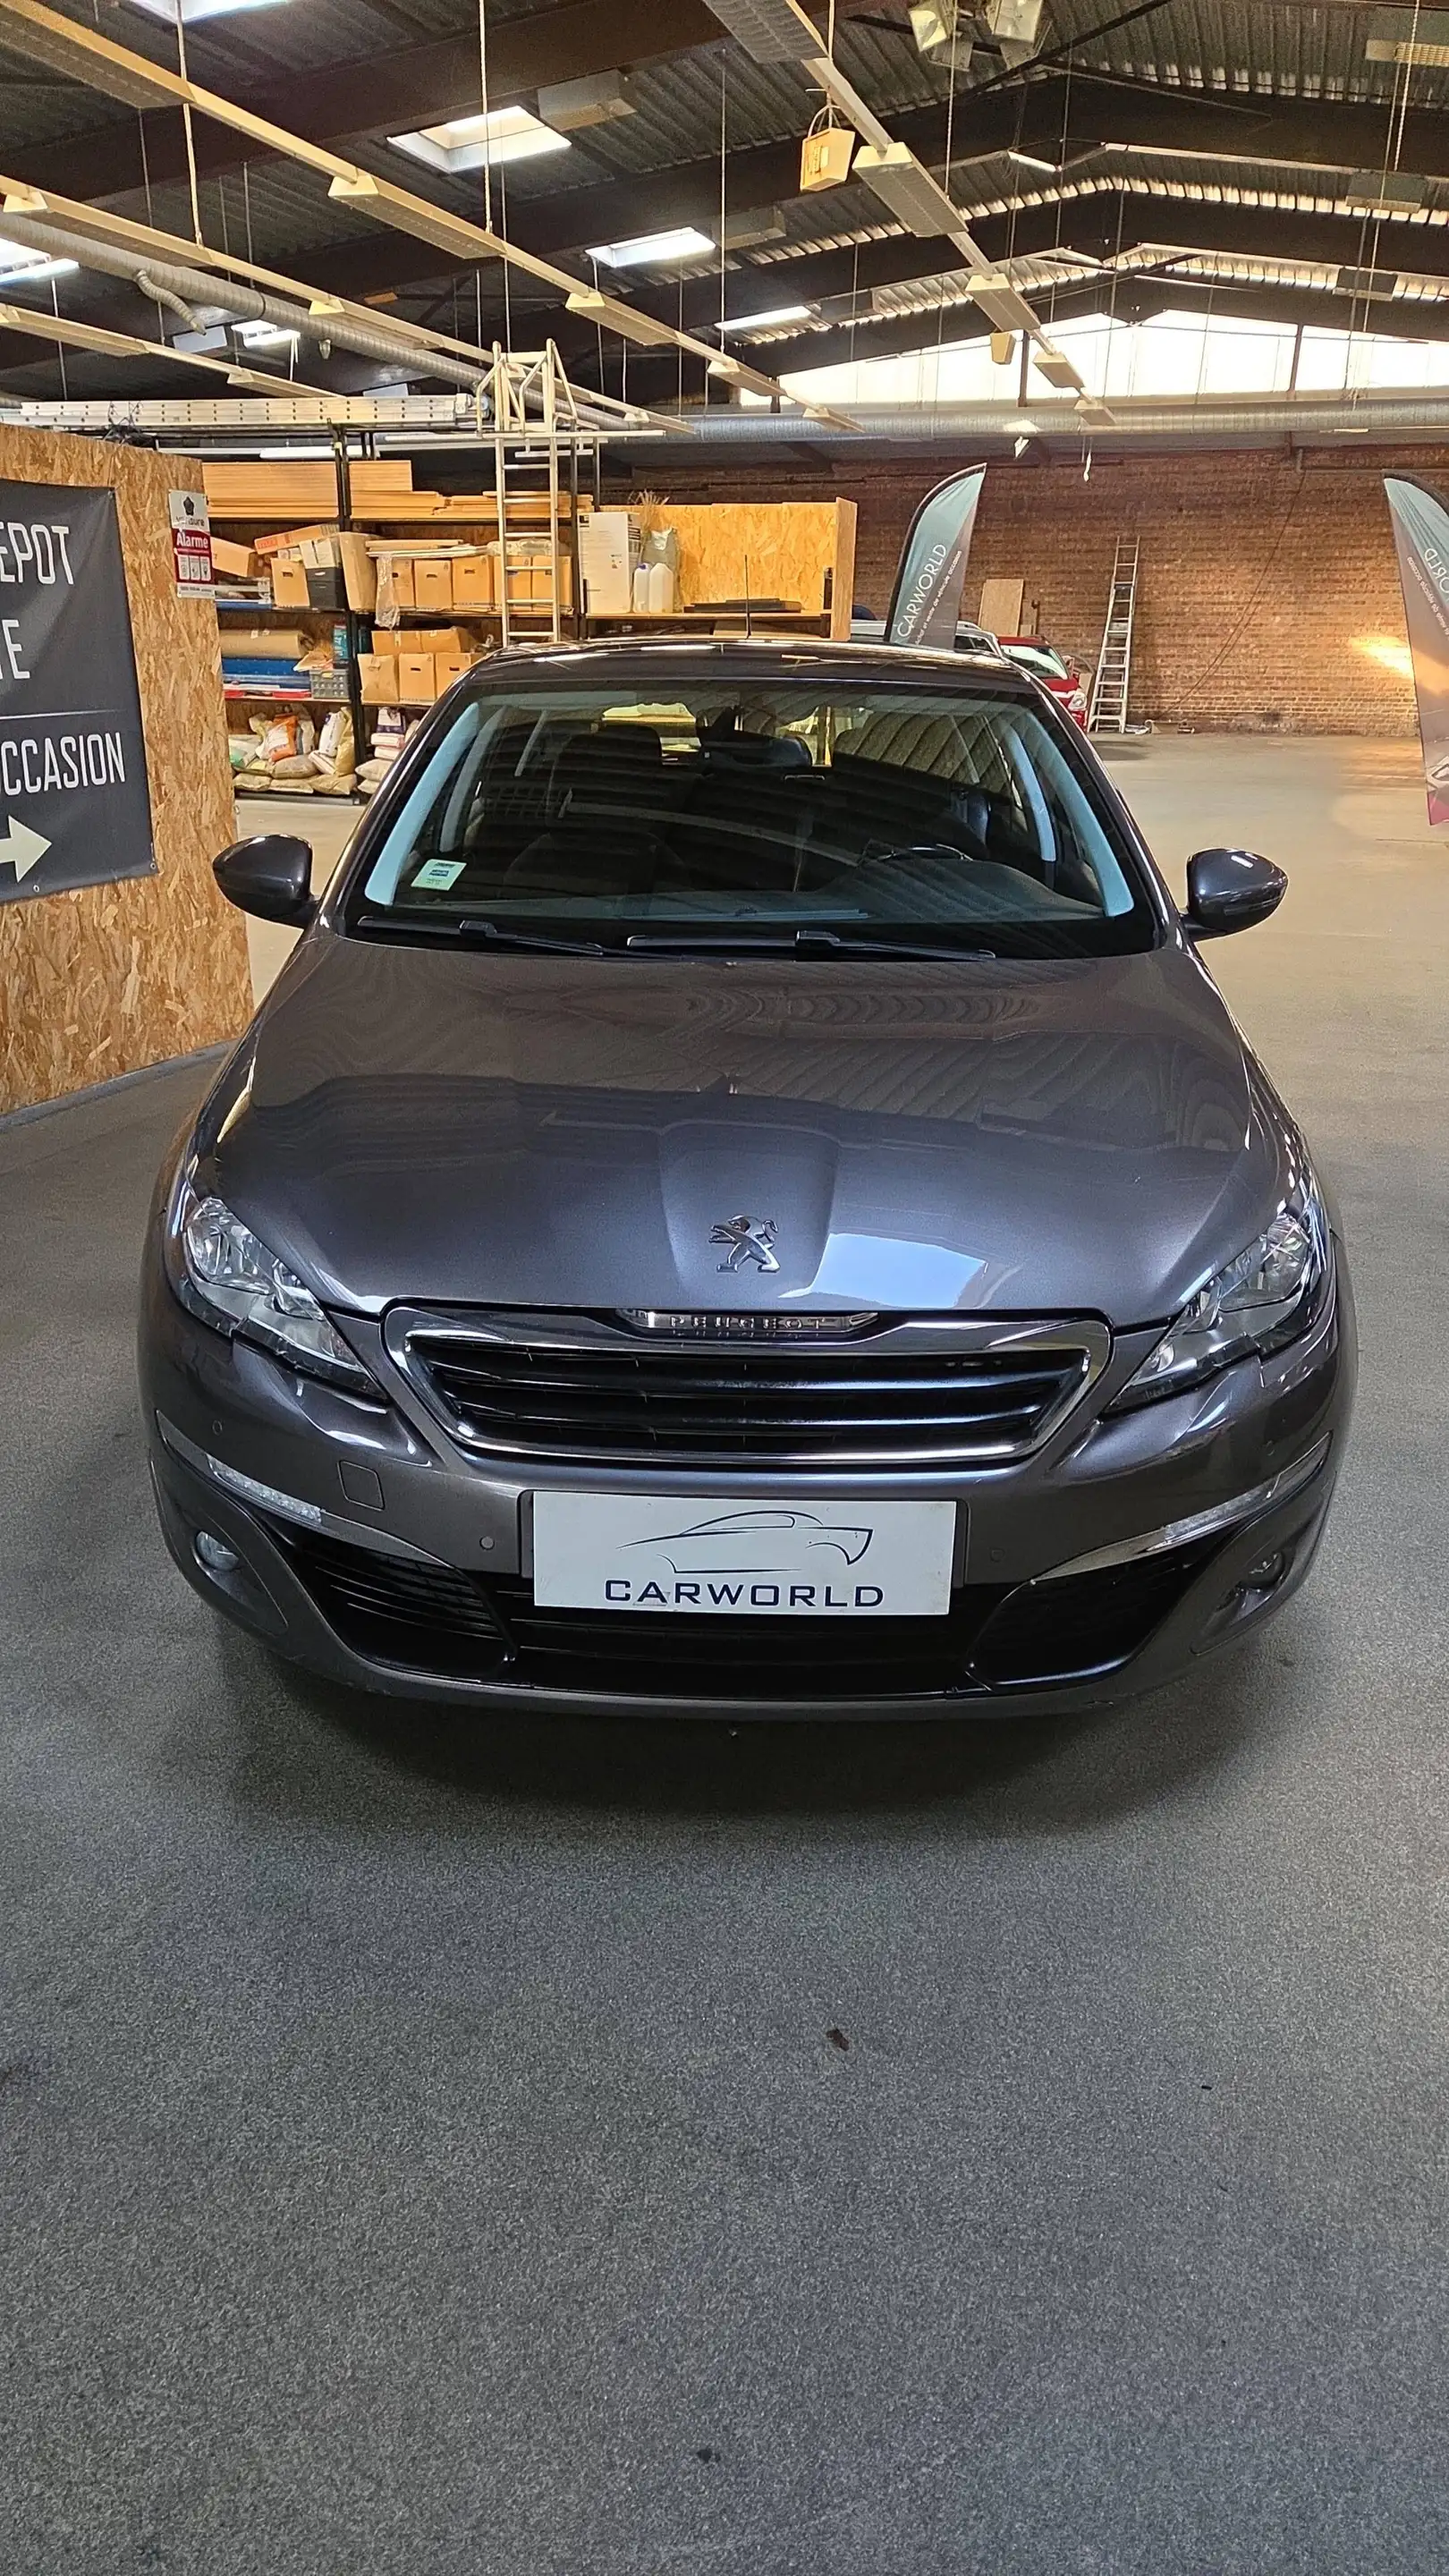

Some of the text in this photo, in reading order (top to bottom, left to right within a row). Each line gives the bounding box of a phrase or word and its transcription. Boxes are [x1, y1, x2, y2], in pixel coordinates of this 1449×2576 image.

[176, 531, 208, 549] Alarme
[897, 544, 947, 637] CARWORLD
[0, 619, 30, 680] E
[0, 732, 126, 796] CCASION
[671, 1315, 826, 1329] PEUGEOT
[605, 1579, 884, 1607] CARWORLD
